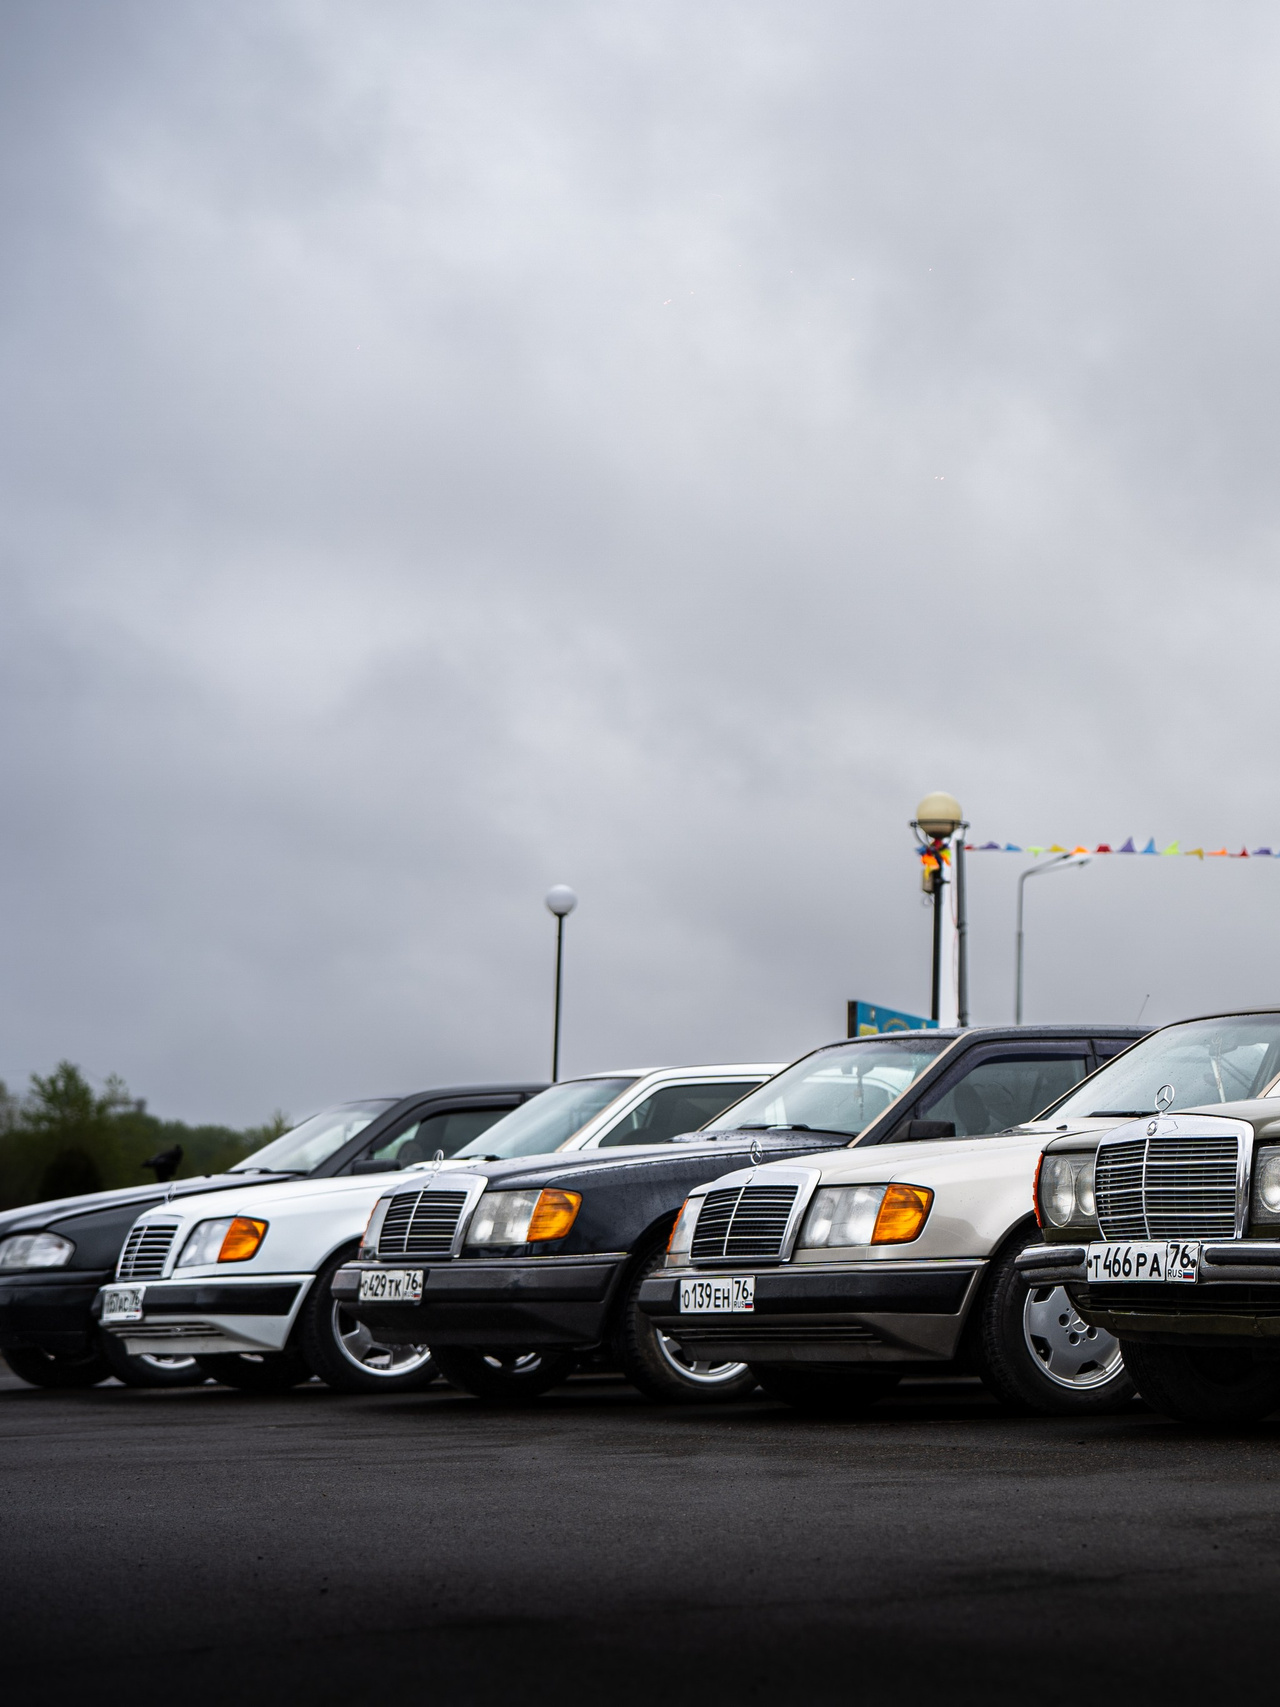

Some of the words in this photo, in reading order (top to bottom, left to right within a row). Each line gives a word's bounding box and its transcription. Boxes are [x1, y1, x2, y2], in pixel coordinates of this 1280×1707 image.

[1169, 1244, 1191, 1269] 76
[405, 1272, 418, 1290] 76
[1167, 1269, 1182, 1278] RUS
[734, 1280, 749, 1301] 76
[733, 1300, 745, 1309] RUS
